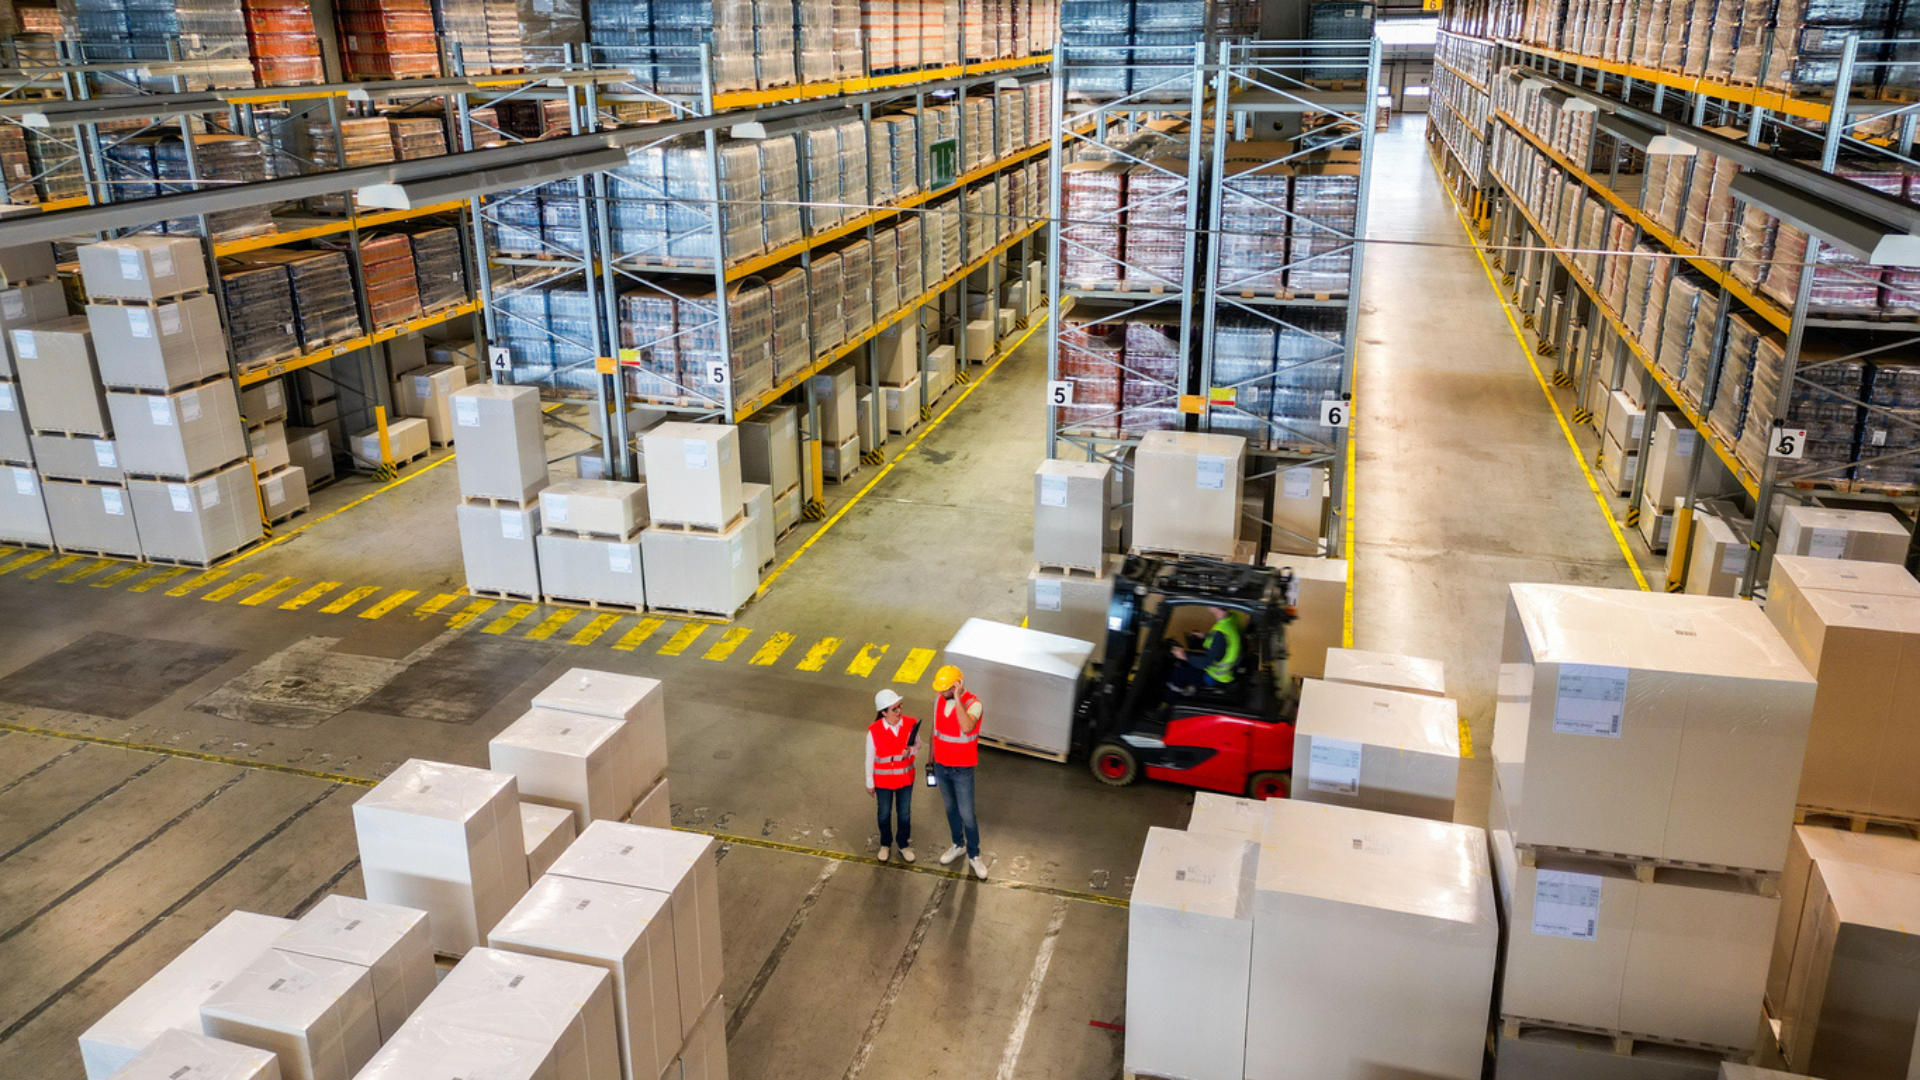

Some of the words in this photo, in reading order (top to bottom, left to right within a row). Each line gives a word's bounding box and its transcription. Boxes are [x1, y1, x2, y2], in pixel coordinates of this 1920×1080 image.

[494, 353, 505, 369] 4
[713, 367, 724, 383] 5
[1054, 387, 1066, 404] 5
[1328, 407, 1342, 425] 6
[1779, 435, 1795, 455] 6
